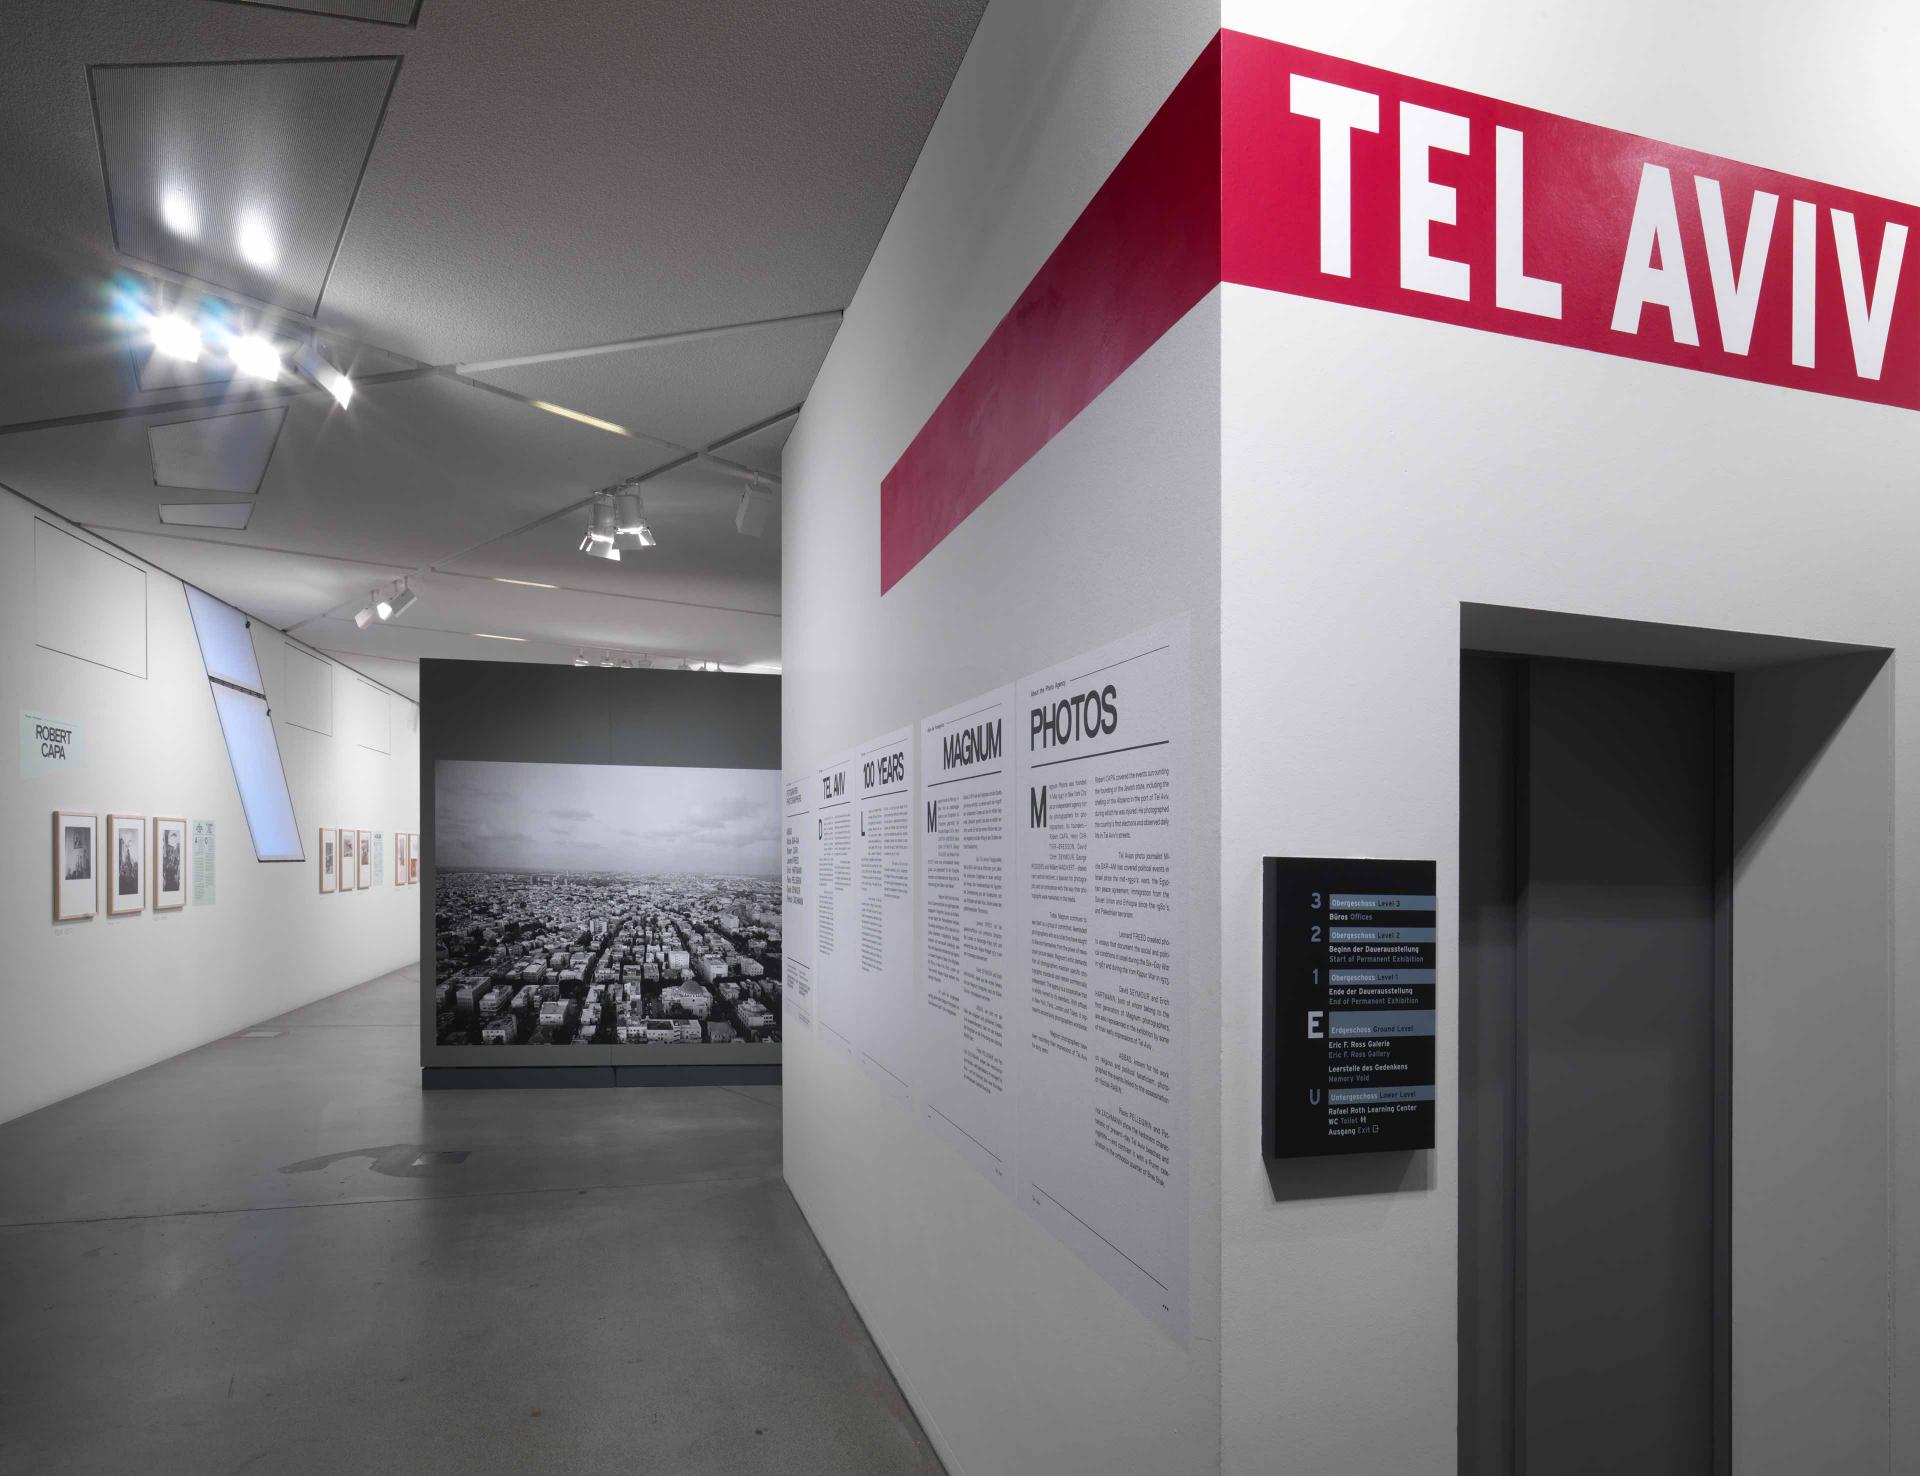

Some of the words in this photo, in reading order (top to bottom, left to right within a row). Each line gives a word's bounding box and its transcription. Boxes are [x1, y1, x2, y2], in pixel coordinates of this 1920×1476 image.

[1290, 73, 1562, 319] TEL
[1611, 163, 1908, 380] AVIV
[1031, 685, 1118, 751] PHOTOS
[36, 724, 72, 745] ROBERT
[41, 743, 66, 760] CAPA
[944, 718, 1001, 770] MAGNUM
[864, 761, 874, 789] 100
[877, 752, 904, 785] YEARS
[823, 776, 832, 800] TEL
[834, 771, 845, 797] AVIV
[1311, 893, 1321, 909] 3
[1332, 899, 1376, 908] Obergeschoss
[1311, 926, 1321, 942] 2
[1331, 932, 1375, 940] Obergeschoss
[1312, 969, 1318, 984] 1
[1331, 974, 1375, 982] Obergeschoss
[1308, 1011, 1323, 1039] E
[1331, 1026, 1371, 1035] Erdgeschoss
[1310, 1089, 1320, 1105] U
[1331, 1094, 1377, 1102] Untergeschoss
[1328, 1127, 1356, 1136] Ausgang
